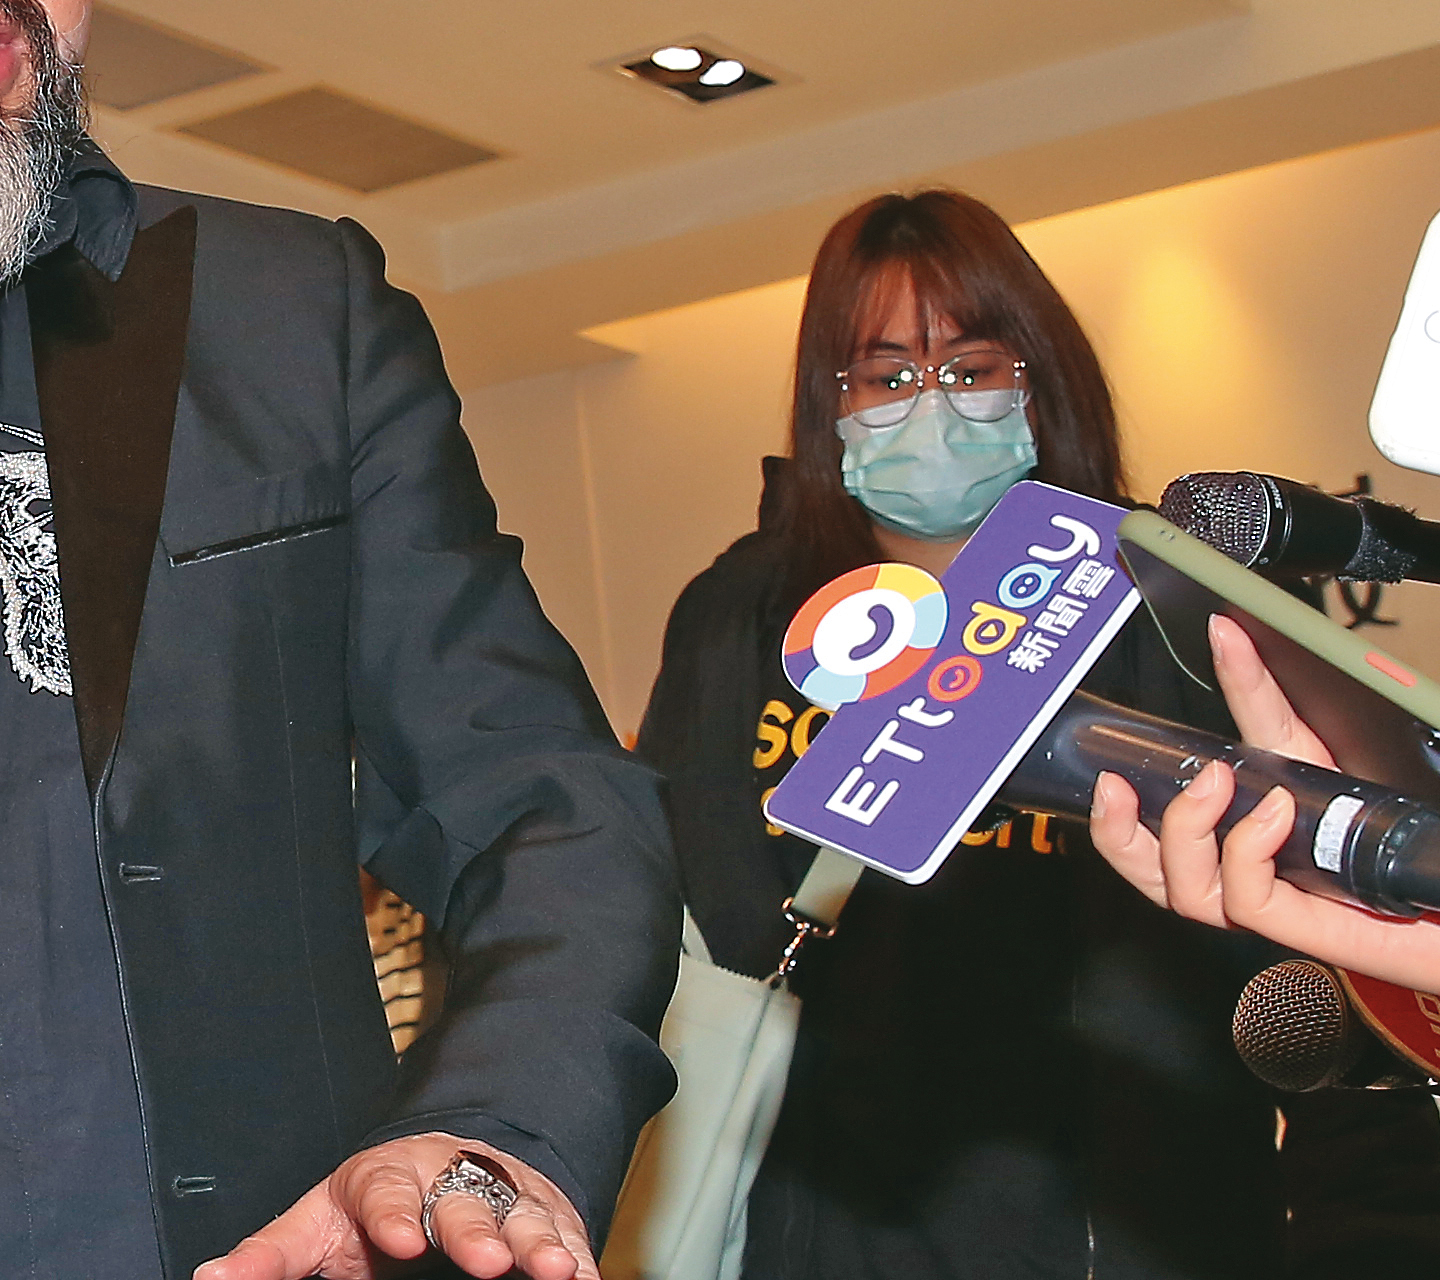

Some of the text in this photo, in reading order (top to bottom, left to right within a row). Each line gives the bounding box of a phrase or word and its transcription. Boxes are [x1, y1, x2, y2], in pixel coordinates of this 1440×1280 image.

[823, 513, 1103, 827] ETtoday
[1006, 557, 1116, 674] 新聞雲
